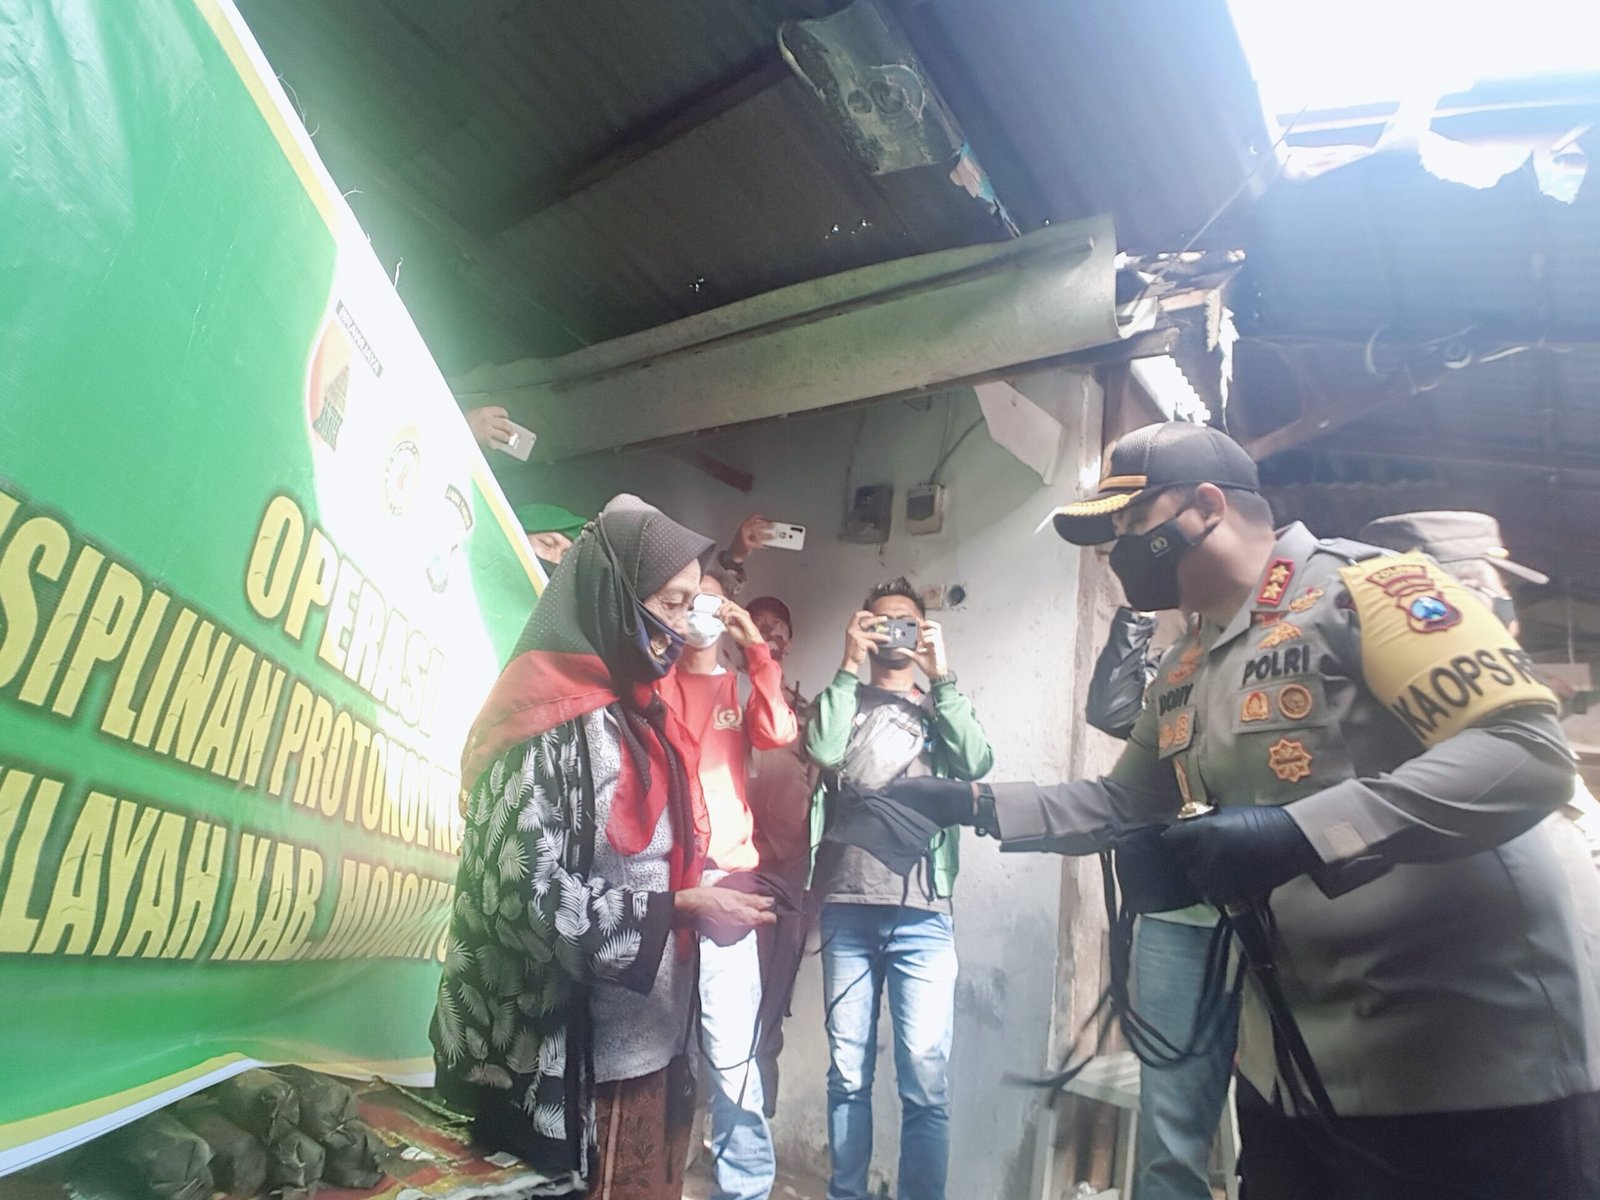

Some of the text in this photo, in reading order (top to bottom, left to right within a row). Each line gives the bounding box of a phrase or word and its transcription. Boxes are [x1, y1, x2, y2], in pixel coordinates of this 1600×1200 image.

[0, 490, 285, 788] SIPLINAN
[270, 681, 429, 847] PROTOKOL
[246, 495, 445, 738] OPERASI
[1242, 645, 1310, 686] POLRI
